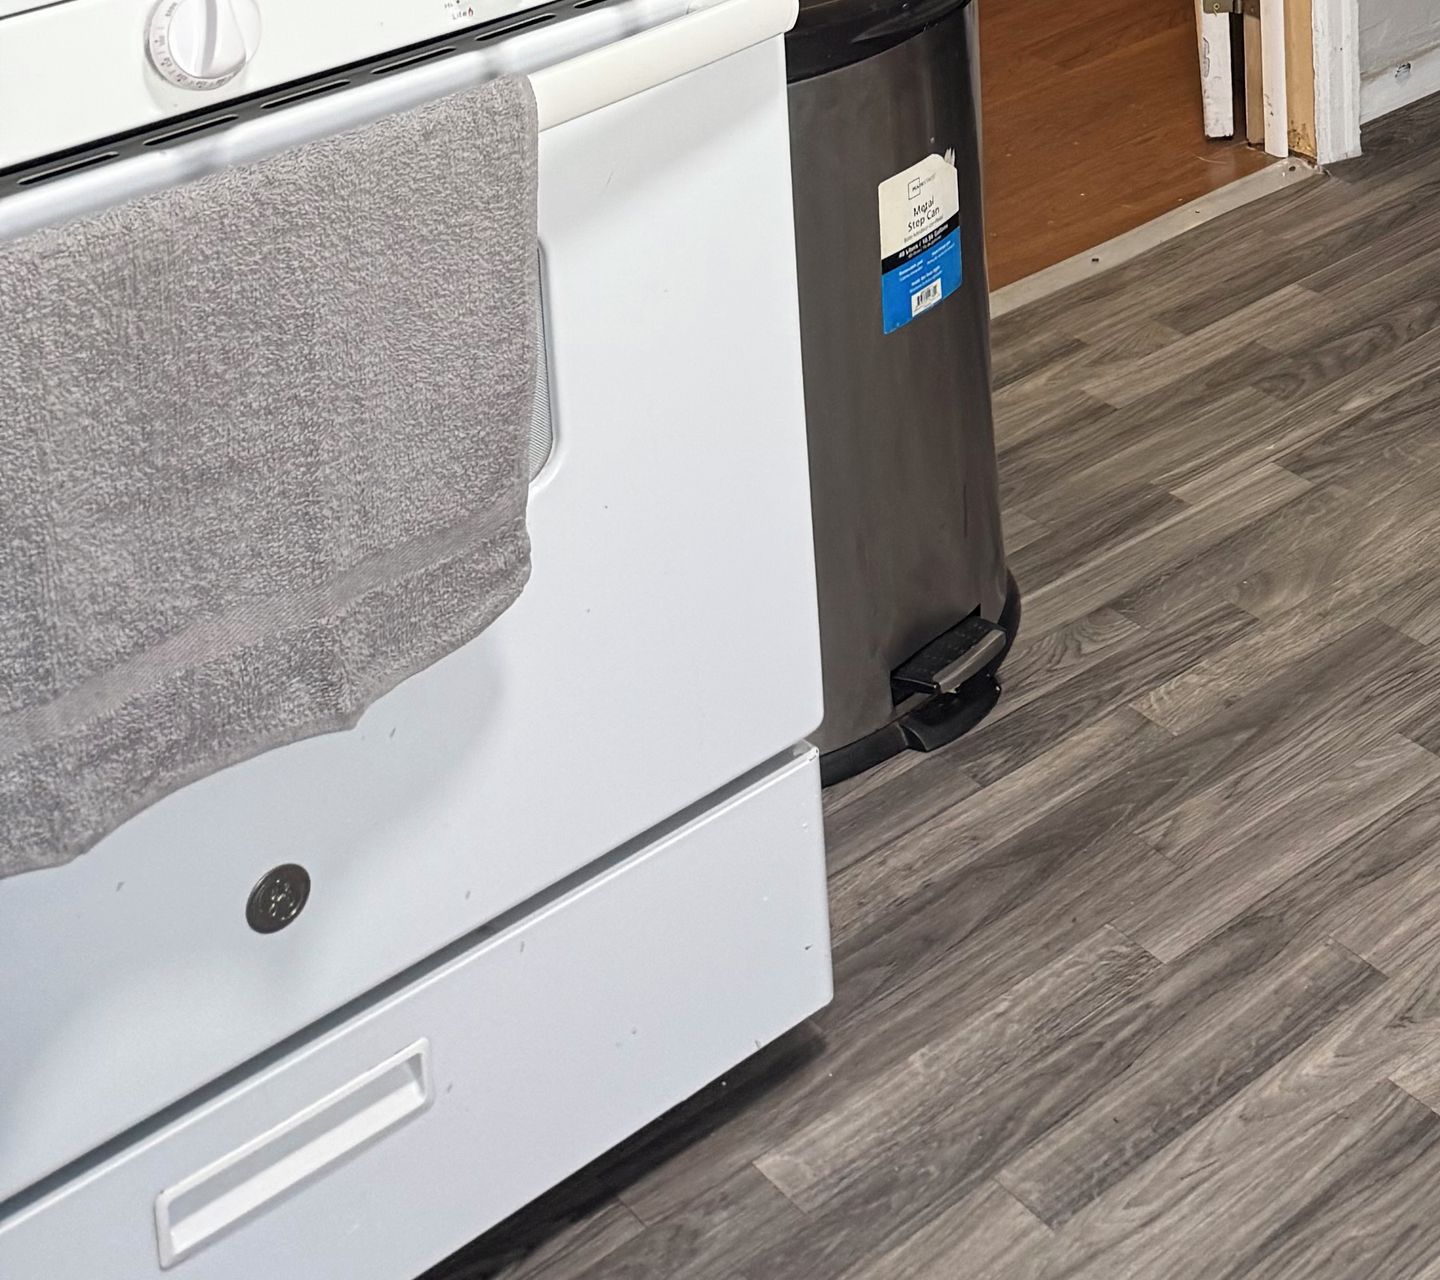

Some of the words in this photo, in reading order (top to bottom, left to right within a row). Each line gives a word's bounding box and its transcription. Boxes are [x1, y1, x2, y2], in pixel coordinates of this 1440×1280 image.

[913, 195, 935, 217] Metal
[908, 217, 926, 232] Step
[926, 207, 940, 220] Can
